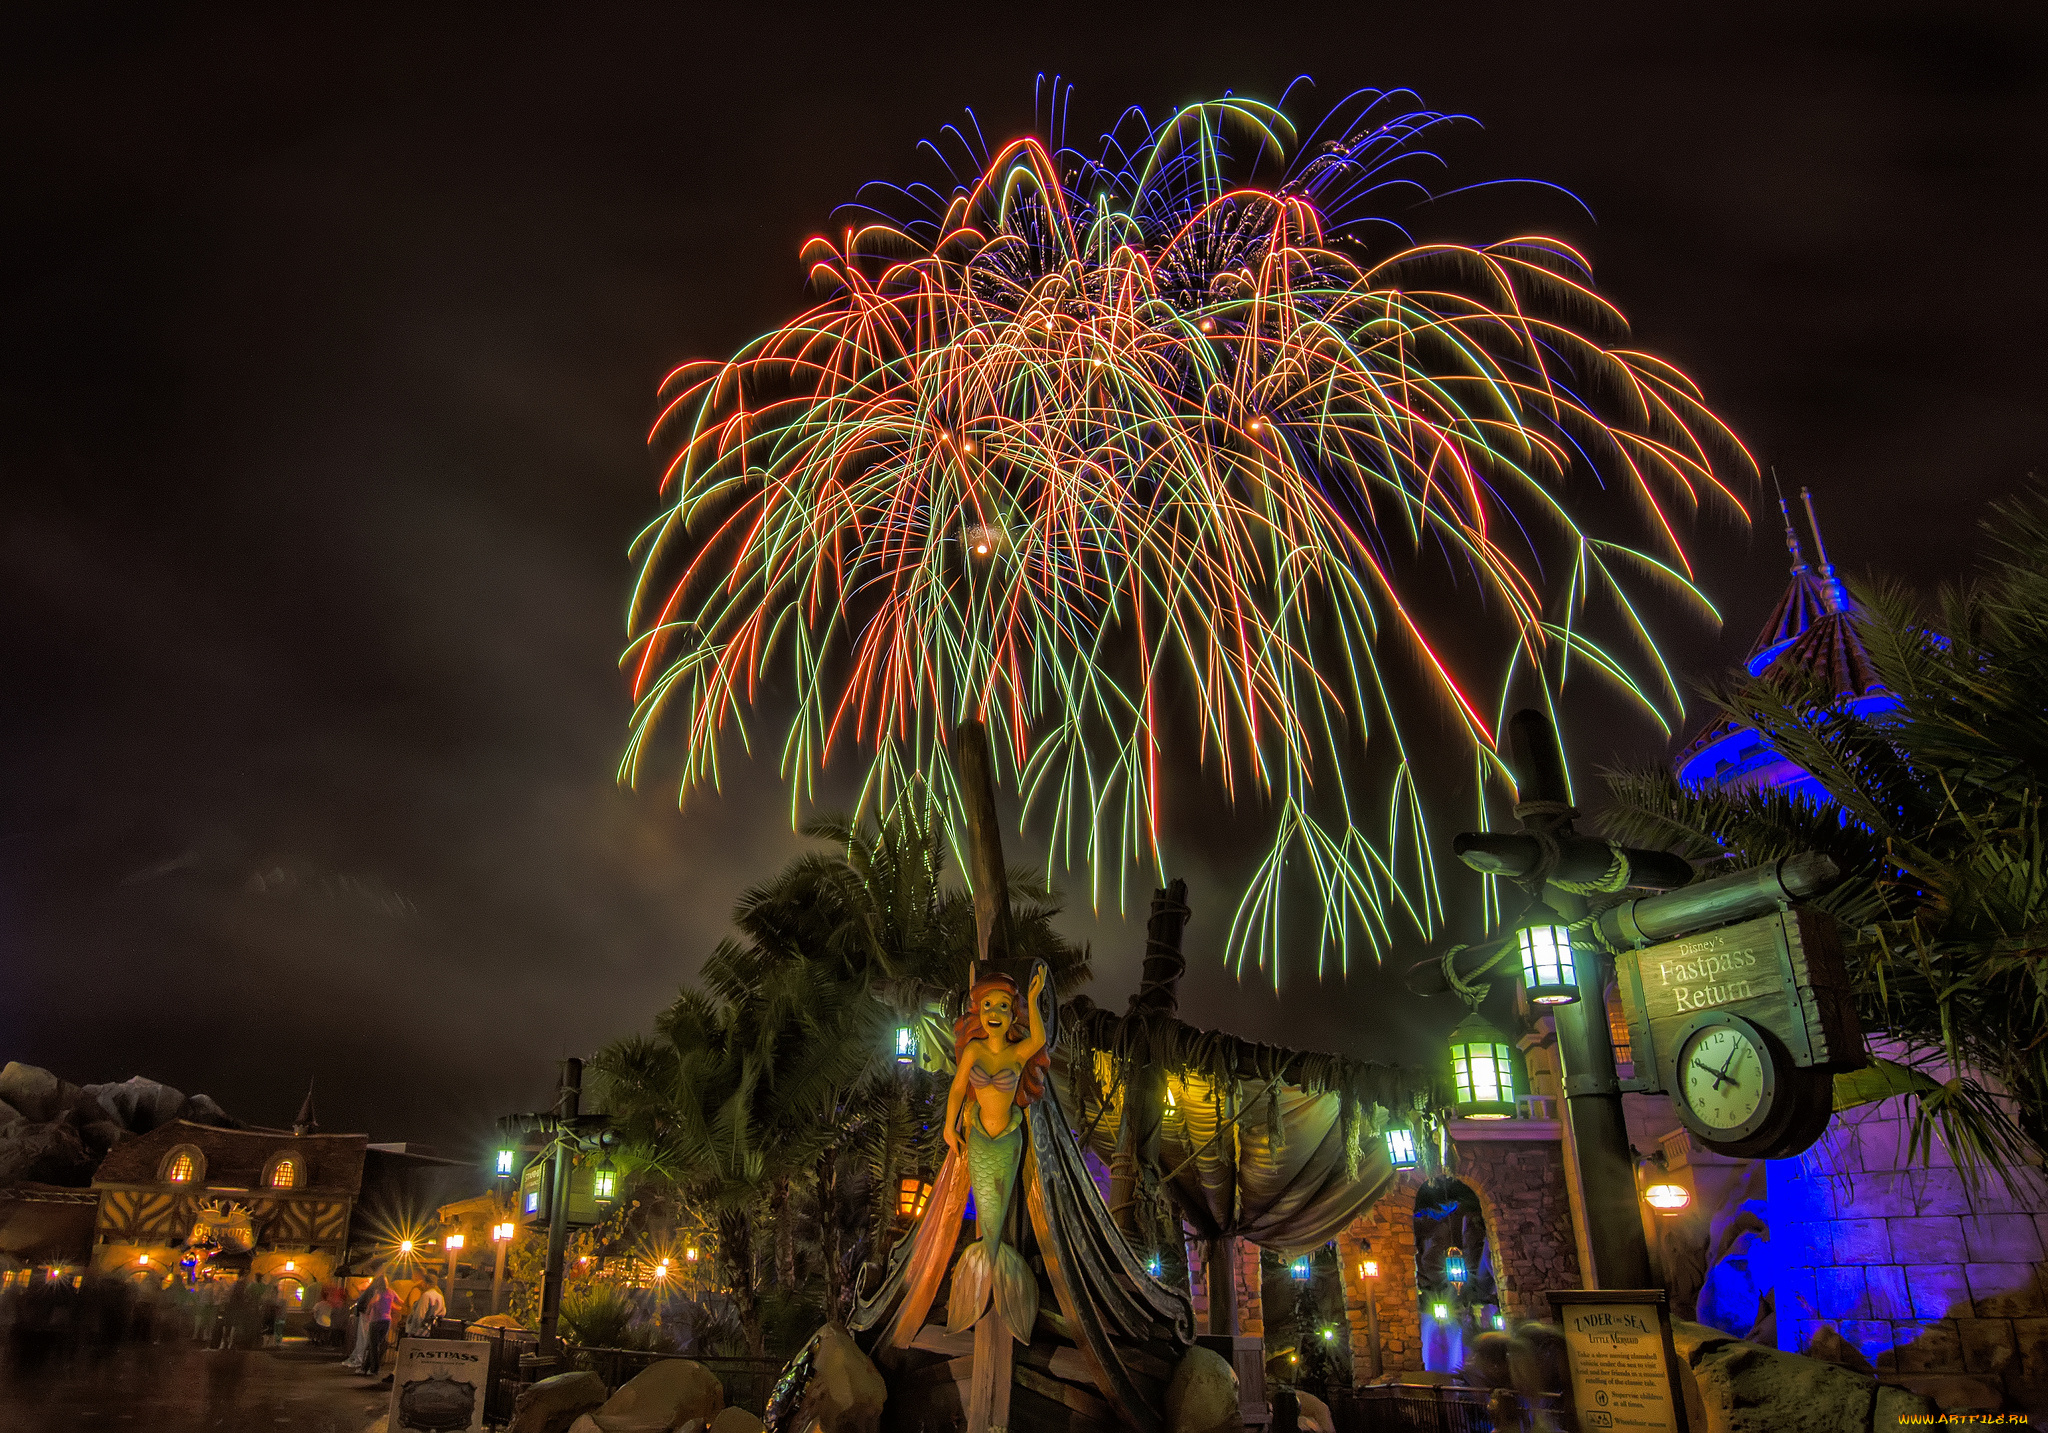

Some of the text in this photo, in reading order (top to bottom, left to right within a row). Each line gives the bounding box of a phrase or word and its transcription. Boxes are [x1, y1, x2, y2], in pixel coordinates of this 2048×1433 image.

[1678, 936, 1725, 956] Disney's
[1659, 948, 1756, 986] Fastpass
[1672, 980, 1753, 1012] Return
[1713, 1033, 1724, 1044] 12
[1699, 1041, 1710, 1052] 11
[1746, 1048, 1753, 1059] 2
[1690, 1058, 1702, 1069] 10
[1754, 1066, 1761, 1078] 3
[1691, 1077, 1698, 1087] 9
[1698, 1097, 1706, 1108] 8
[1714, 1107, 1720, 1119] 7
[1745, 1103, 1752, 1115] 5
[1729, 1110, 1736, 1121] 6
[1574, 1313, 1613, 1332] UNDER
[1623, 1314, 1651, 1333] SEA
[1588, 1332, 1639, 1345] LITTLE MERMAID
[409, 1351, 479, 1362] FASTPASS
